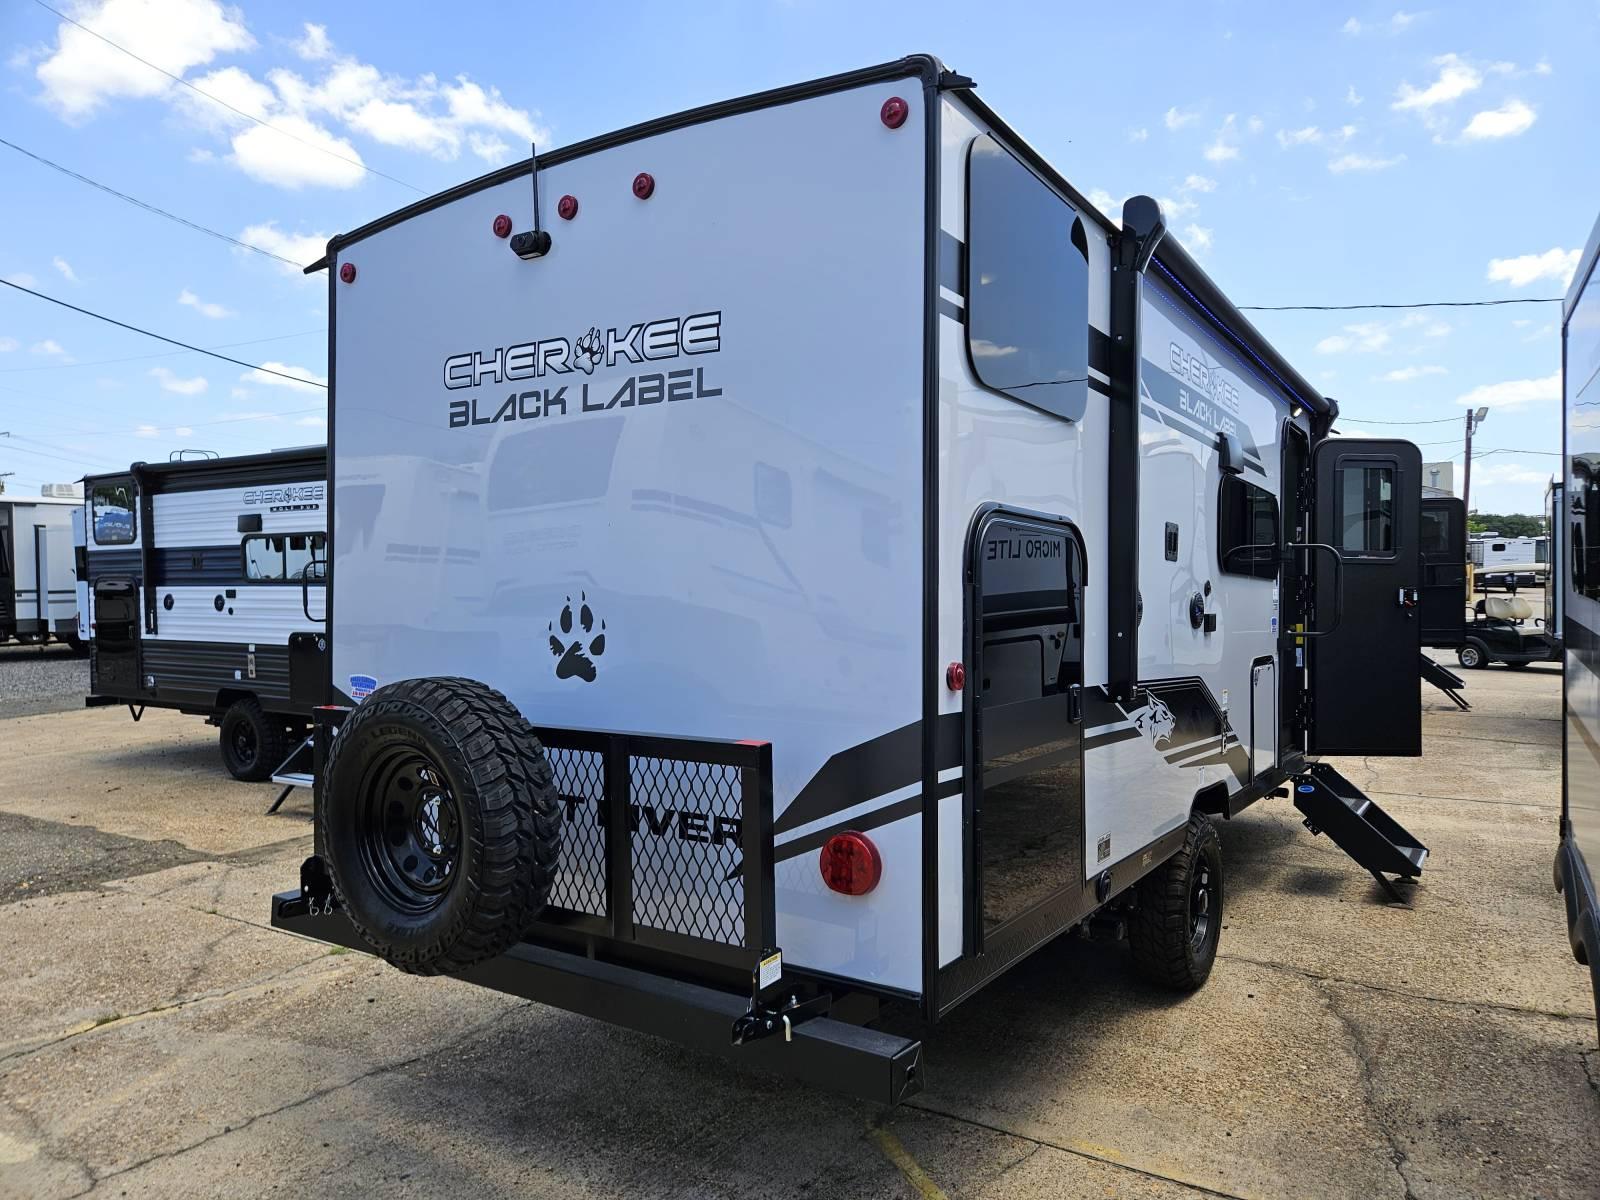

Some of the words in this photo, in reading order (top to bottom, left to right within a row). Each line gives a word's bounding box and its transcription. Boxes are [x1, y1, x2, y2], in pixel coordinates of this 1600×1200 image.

[449, 386, 569, 428] BLACK
[582, 366, 723, 412] LABEL
[1179, 388, 1212, 425] BLACK
[1214, 410, 1238, 437] LABEL
[597, 799, 744, 849] IVER
